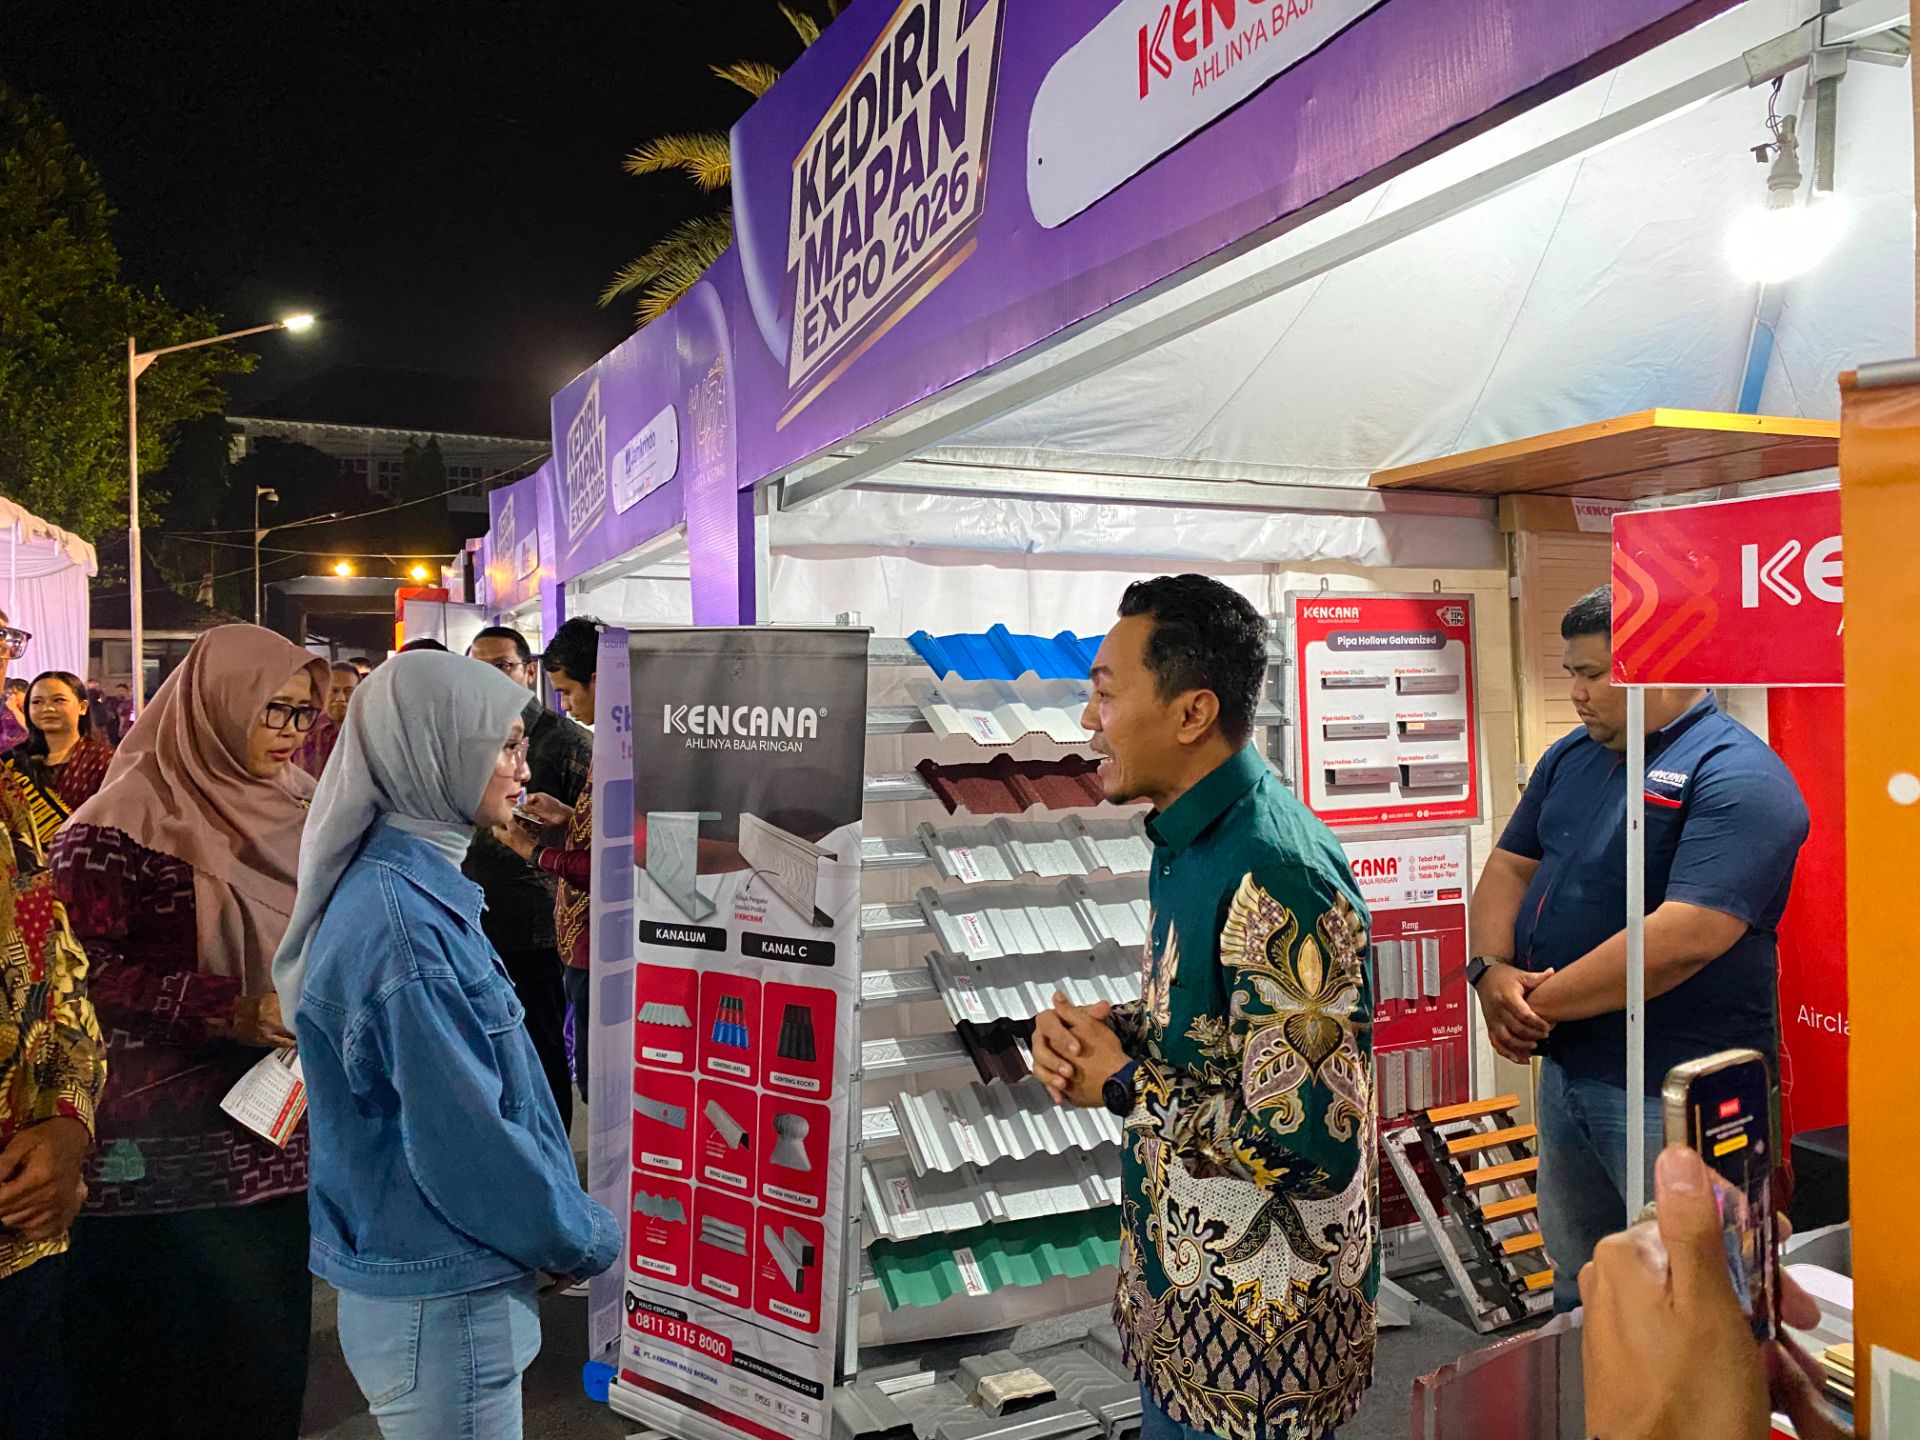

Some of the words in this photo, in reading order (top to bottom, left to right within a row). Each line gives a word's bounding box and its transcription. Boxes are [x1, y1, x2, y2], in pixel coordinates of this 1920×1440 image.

[1138, 0, 1266, 100] KEN
[1192, 18, 1268, 96] AHLINYA
[1271, 0, 1315, 37] BAJ
[799, 0, 941, 241] KEDIRI
[804, 43, 970, 309] MAPAN
[803, 239, 886, 353] EXPO
[892, 151, 969, 276] 2026
[569, 392, 597, 473] KEDIRI
[570, 428, 602, 505] MAPAN
[571, 490, 589, 530] EXPO
[1303, 606, 1359, 619] KENCANA
[1337, 635, 1357, 648] Pipa
[1358, 635, 1388, 646] Hollow
[1389, 634, 1437, 646] Galvanized
[685, 738, 732, 750] AHLINYA
[733, 739, 757, 751] BAJA
[759, 740, 803, 753] RINGAN
[1351, 857, 1398, 877] CANA
[656, 928, 706, 943] KANALUM
[1401, 921, 1419, 930] Reng
[762, 941, 796, 956] KANAL
[798, 946, 808, 957] C
[1432, 1026, 1445, 1034] Wall
[1446, 1024, 1463, 1034] Angle
[774, 1075, 796, 1085] GENTENG
[635, 1312, 663, 1333] 0811
[667, 1322, 696, 1344] 3115
[698, 1335, 726, 1357] 8000
